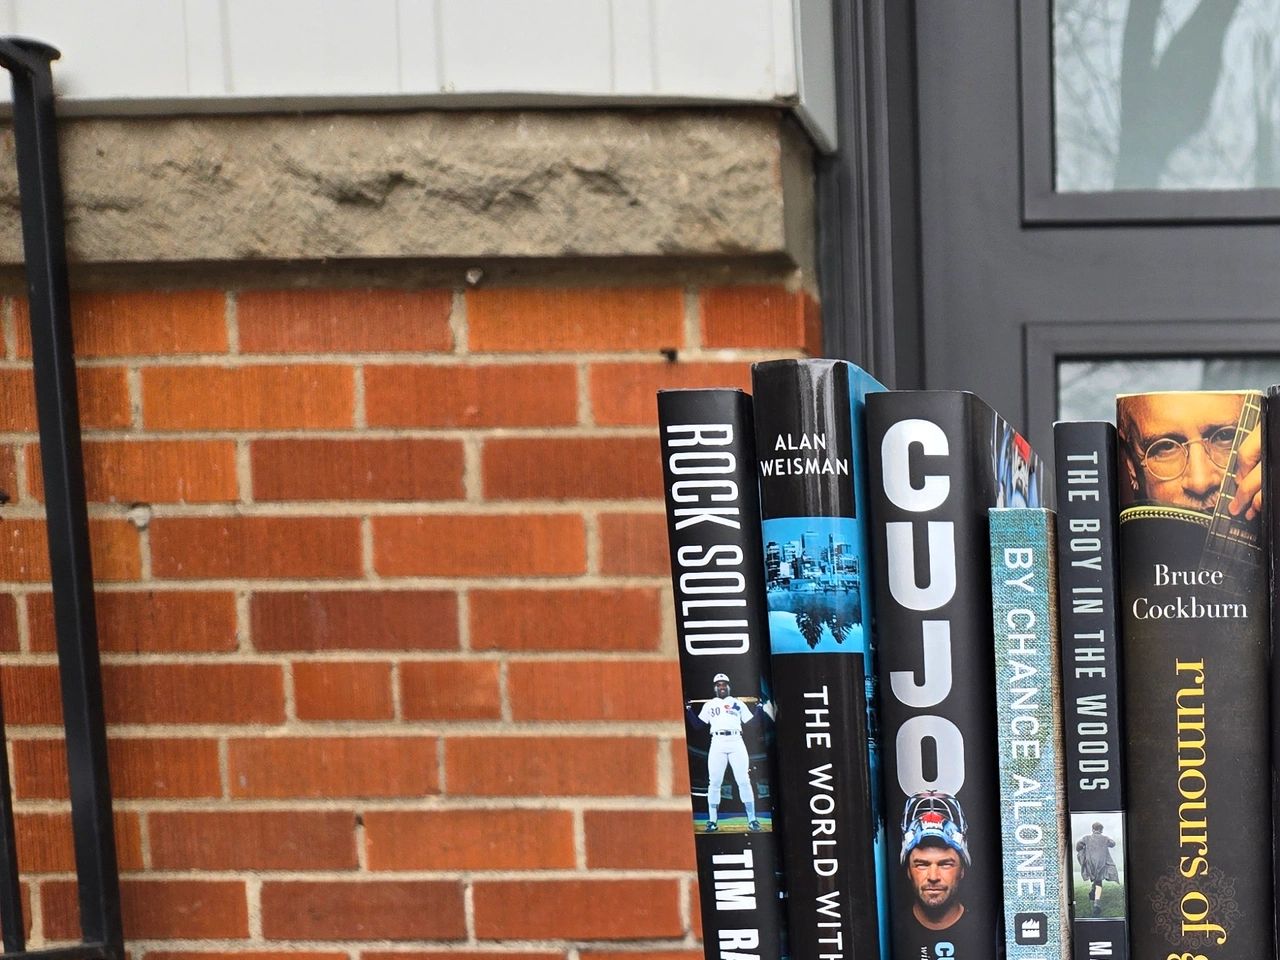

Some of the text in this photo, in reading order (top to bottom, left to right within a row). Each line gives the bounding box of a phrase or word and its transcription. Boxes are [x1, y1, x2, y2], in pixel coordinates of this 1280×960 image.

[760, 458, 849, 477] WEISMAN
[774, 433, 827, 452] ALAN
[667, 423, 750, 655] ROCK SOLID
[1003, 547, 1035, 593] BY
[1154, 564, 1224, 587] Bruce
[881, 418, 965, 798] CUJO
[1066, 451, 1110, 791] THE BOY IN THE WOODS
[1132, 598, 1249, 620] Cockburn
[1006, 609, 1041, 759] CHANCE
[803, 686, 831, 749] THE
[1175, 657, 1209, 879] rumours
[808, 763, 840, 878] WORLD
[1012, 771, 1045, 898] ALONE
[711, 848, 754, 910] TIM
[1179, 890, 1227, 945] of
